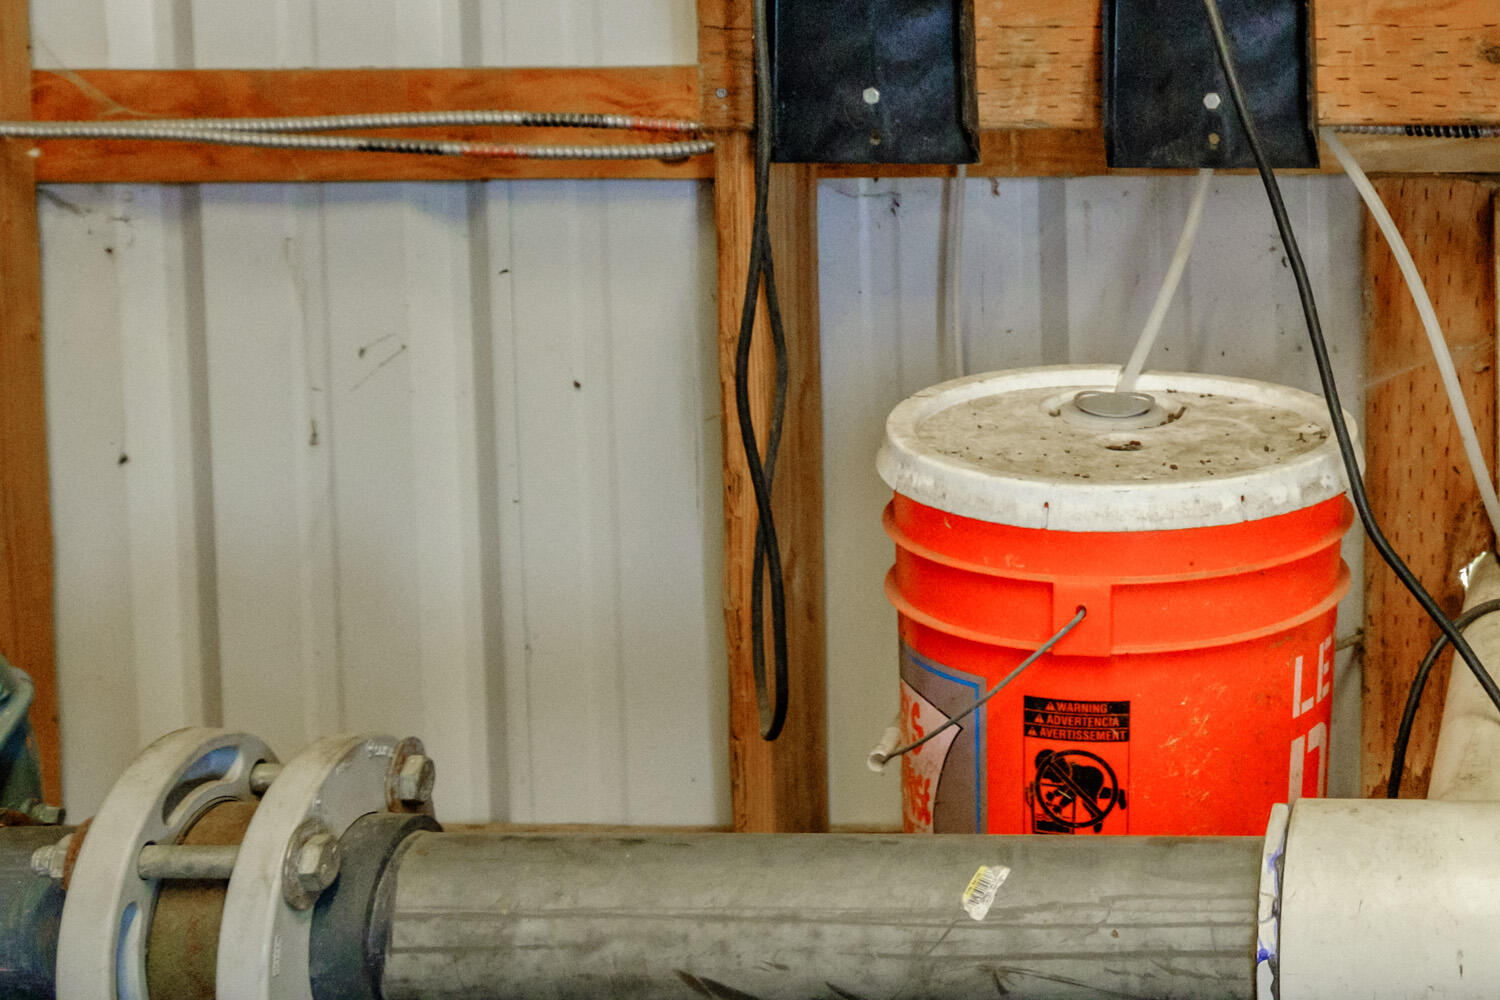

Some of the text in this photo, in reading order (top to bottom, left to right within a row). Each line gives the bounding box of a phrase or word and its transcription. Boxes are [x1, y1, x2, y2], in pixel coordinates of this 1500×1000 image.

[1055, 701, 1108, 714] WARNING
[1046, 713, 1120, 728] ADVERTENCIA
[1039, 727, 1126, 741] AVERTISSEMENT
